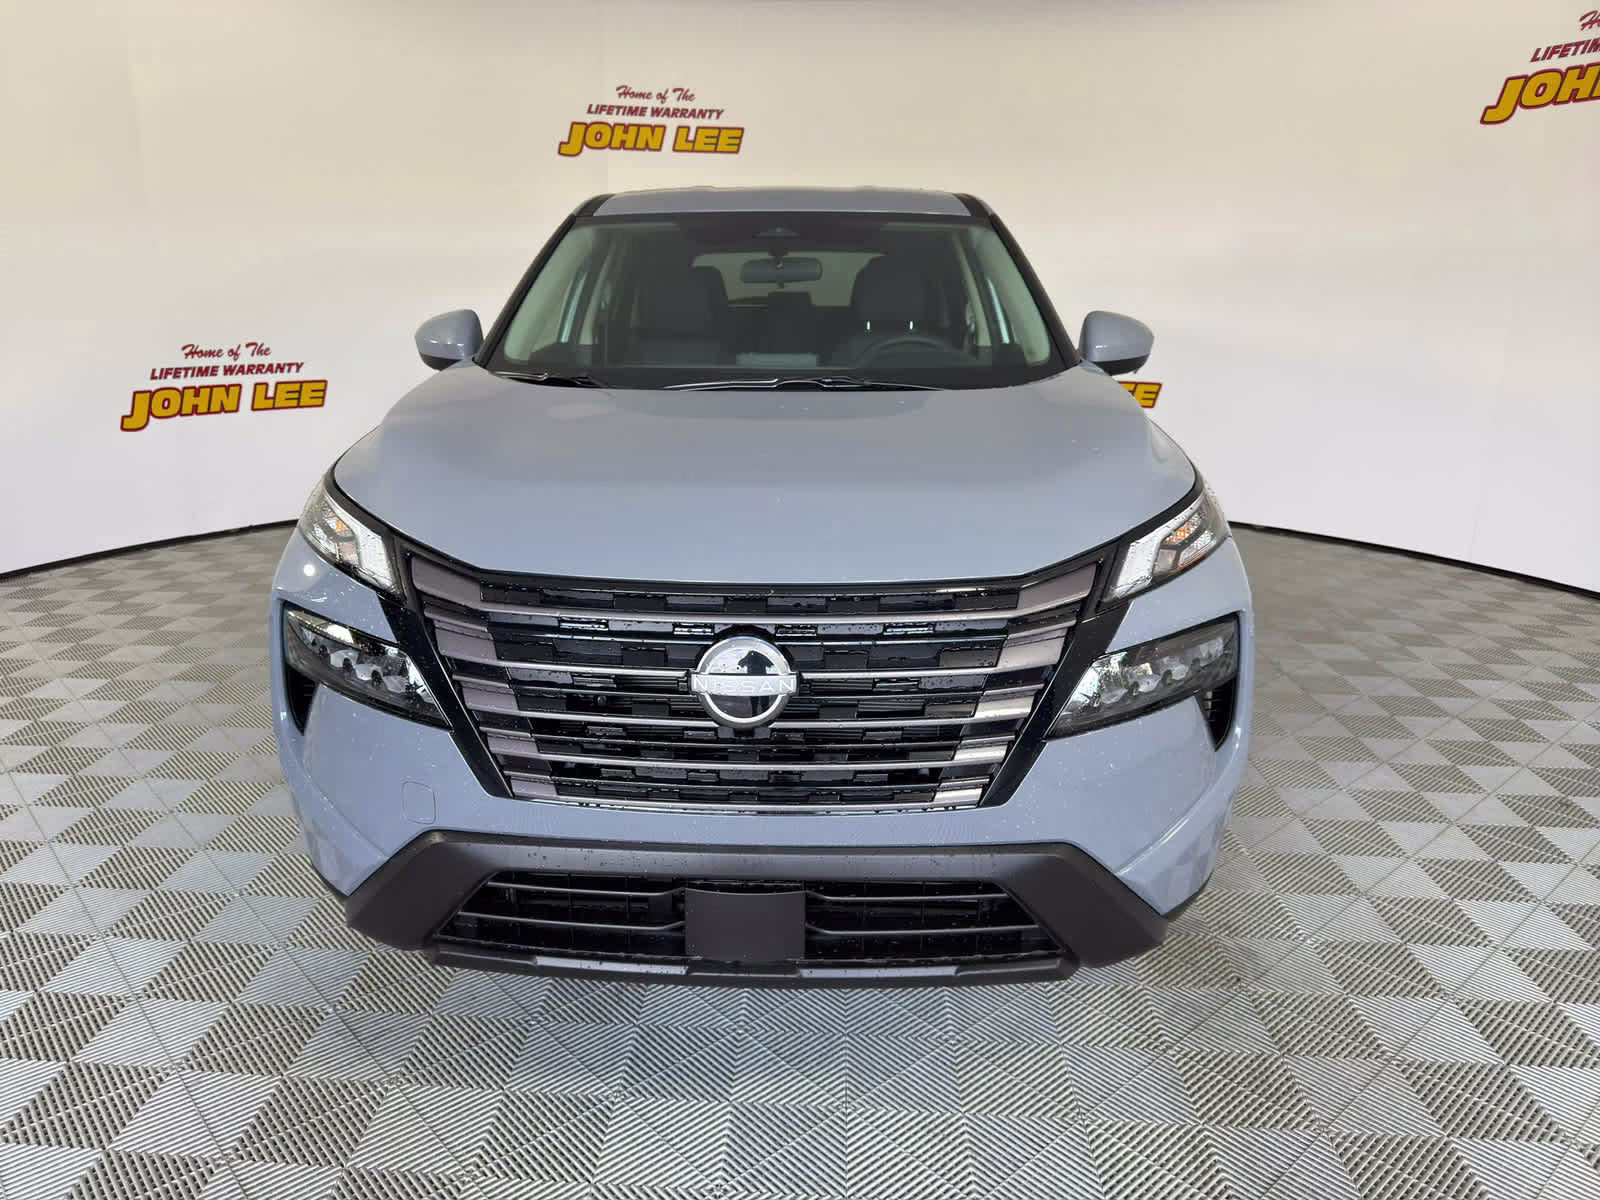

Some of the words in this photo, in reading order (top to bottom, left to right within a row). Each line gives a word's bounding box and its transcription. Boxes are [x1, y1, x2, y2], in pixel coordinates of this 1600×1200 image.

[616, 85, 652, 101] Home
[656, 88, 669, 104] of
[672, 88, 696, 102] The
[1480, 62, 1600, 125] JOH
[586, 104, 648, 117] LIFETIME
[650, 106, 724, 120] WARRANTY
[558, 121, 666, 157] JOHN
[672, 125, 745, 154] LEE
[181, 344, 224, 359] Home
[227, 344, 241, 361] of
[245, 342, 271, 357] The
[150, 365, 219, 380] LIFETIME
[223, 361, 304, 376] WARRANTY
[120, 383, 242, 432] JOHN
[250, 379, 328, 411] LEE
